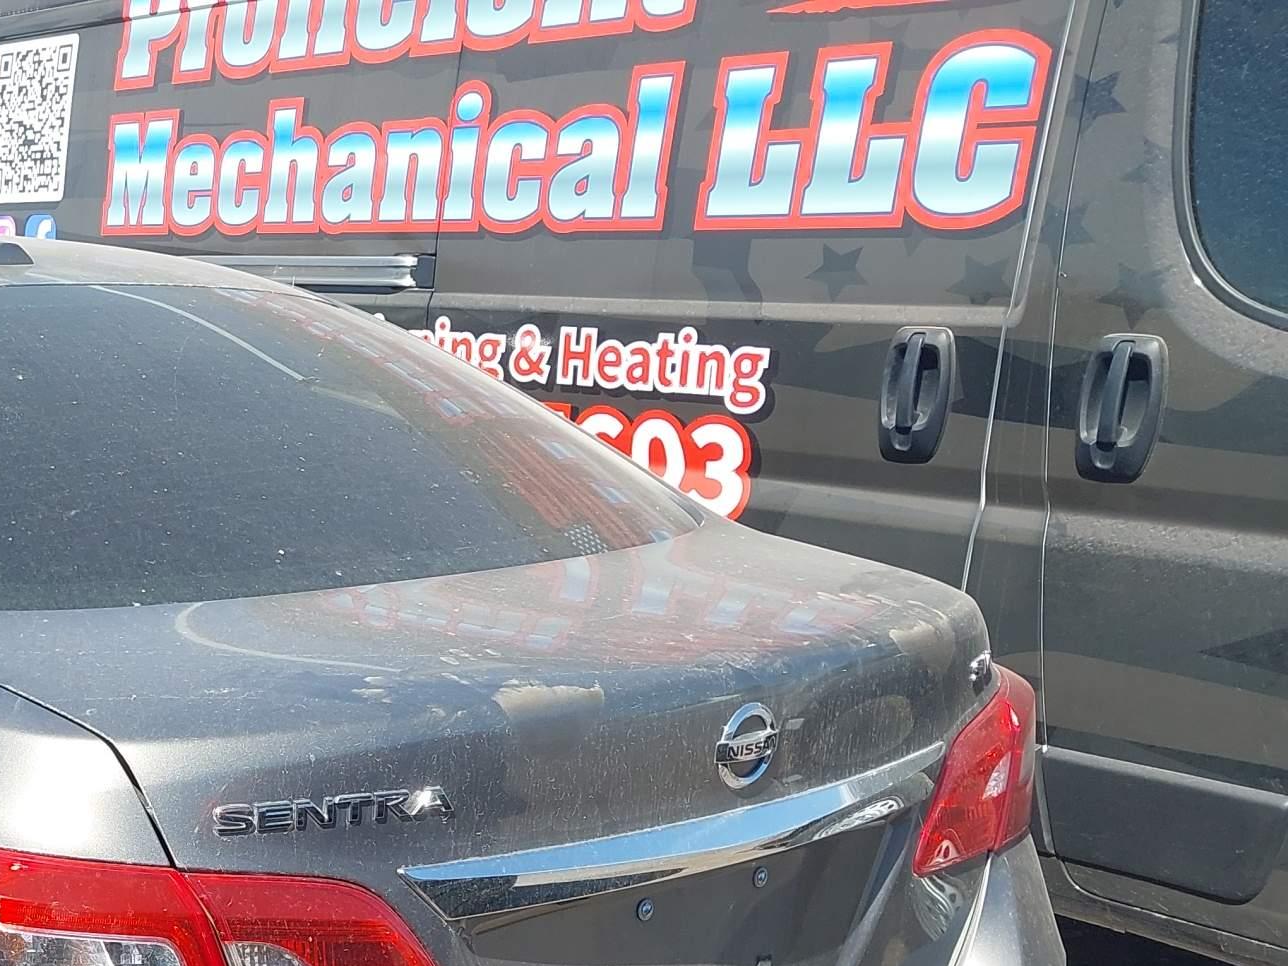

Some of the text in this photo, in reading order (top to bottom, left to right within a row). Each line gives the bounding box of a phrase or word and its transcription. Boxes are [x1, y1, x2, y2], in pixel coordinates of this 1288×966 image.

[102, 66, 685, 235] Mechanical
[698, 34, 1049, 226] LLC
[511, 326, 549, 382] &
[559, 328, 769, 411] Heating
[726, 735, 776, 757] NISSAN
[212, 786, 454, 836] SENTRA
